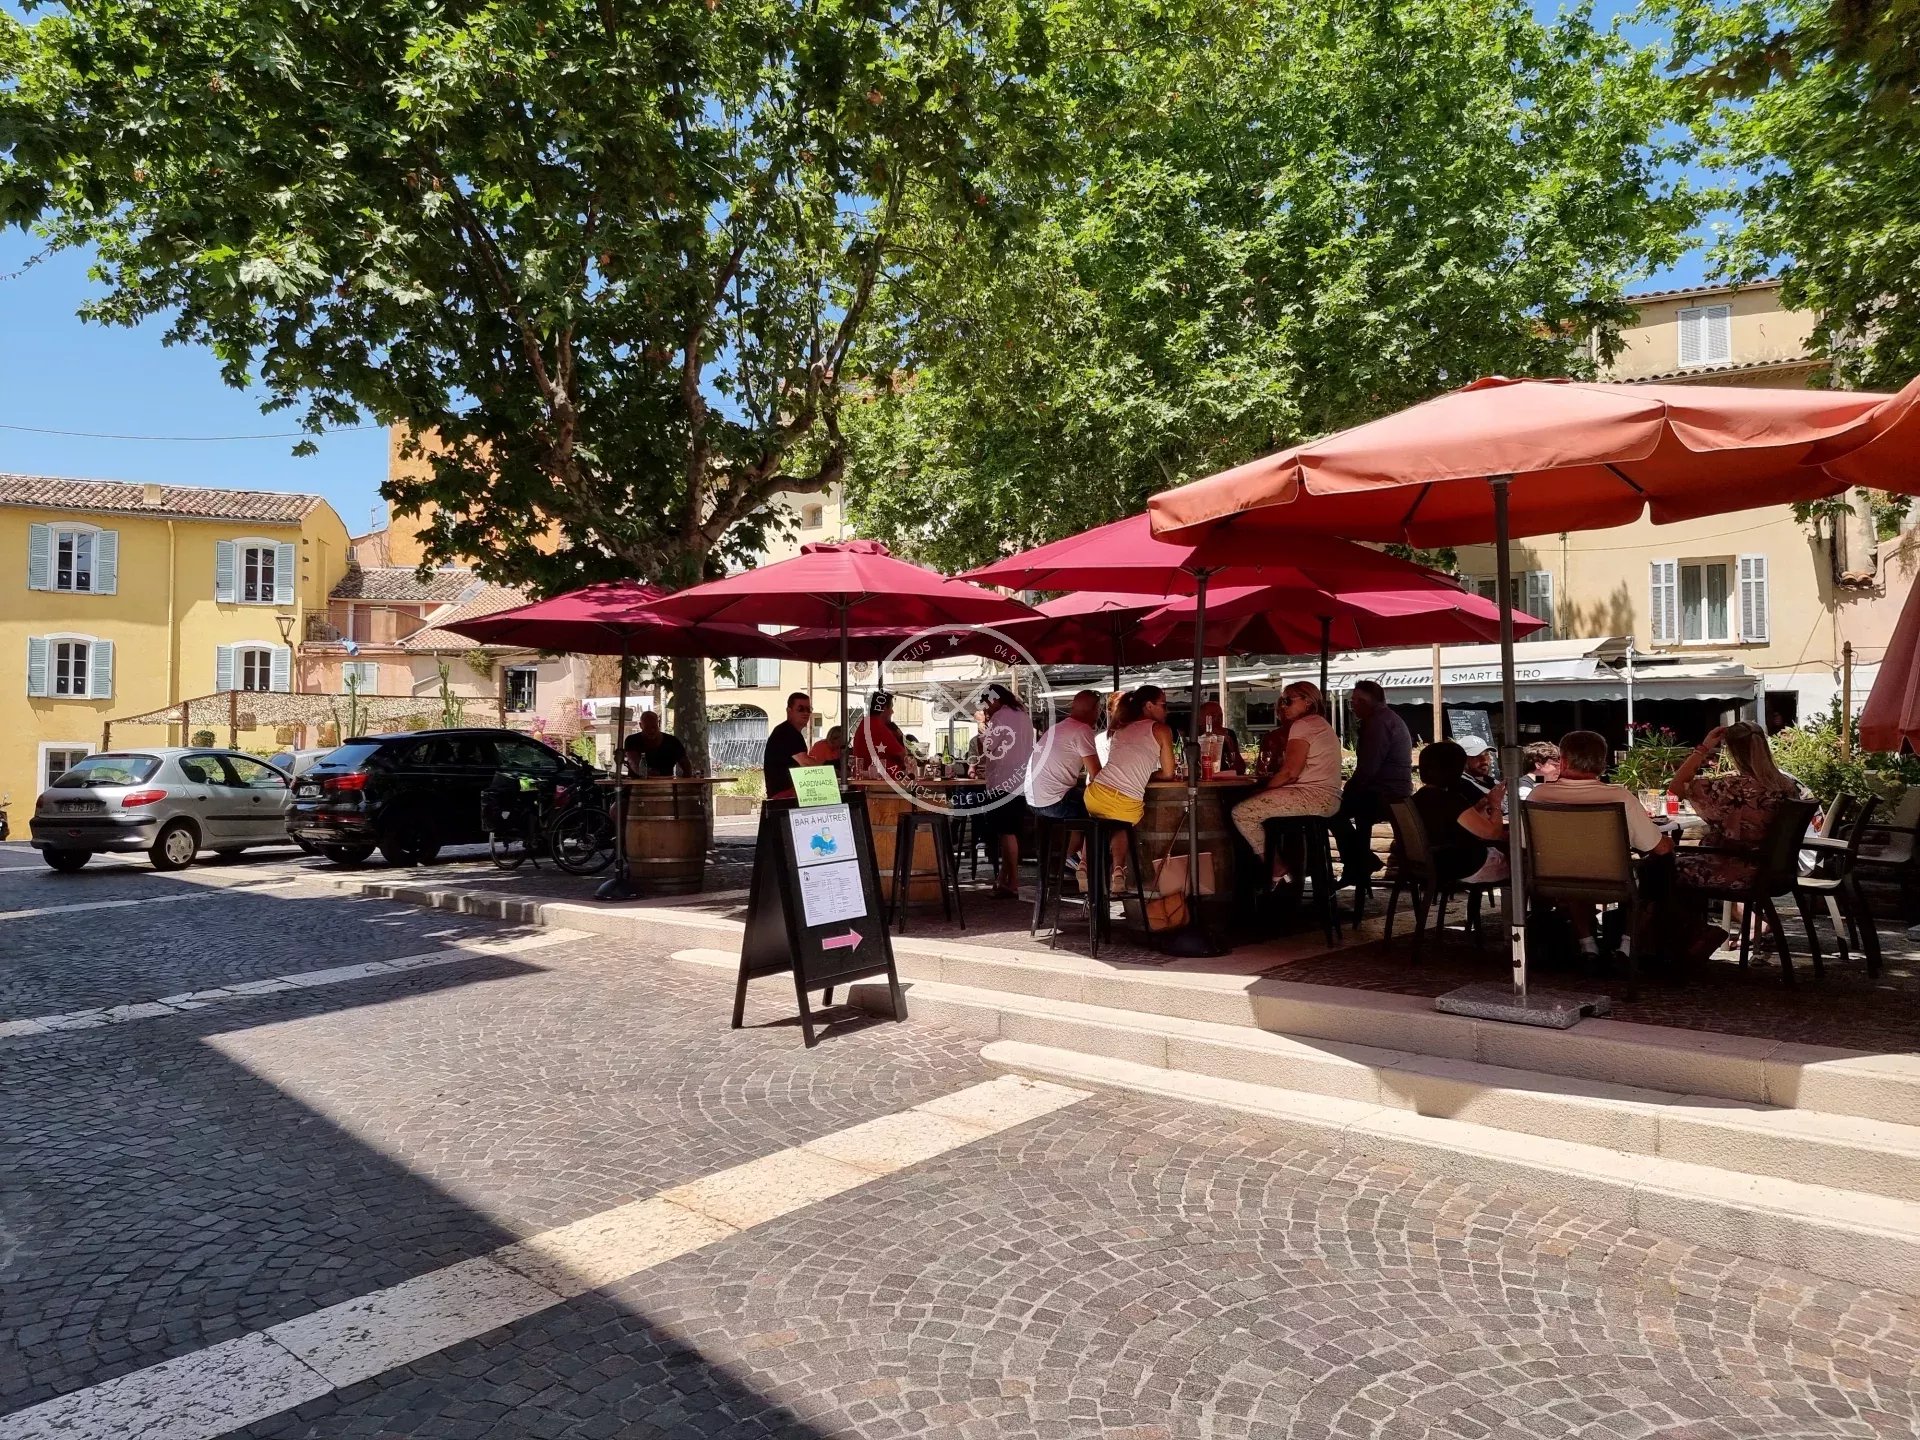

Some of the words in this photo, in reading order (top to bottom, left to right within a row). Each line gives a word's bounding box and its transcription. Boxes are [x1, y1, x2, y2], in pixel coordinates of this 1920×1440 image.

[1451, 671, 1492, 682] SMART
[1496, 669, 1541, 680] BTRO
[795, 817, 810, 827] BAR
